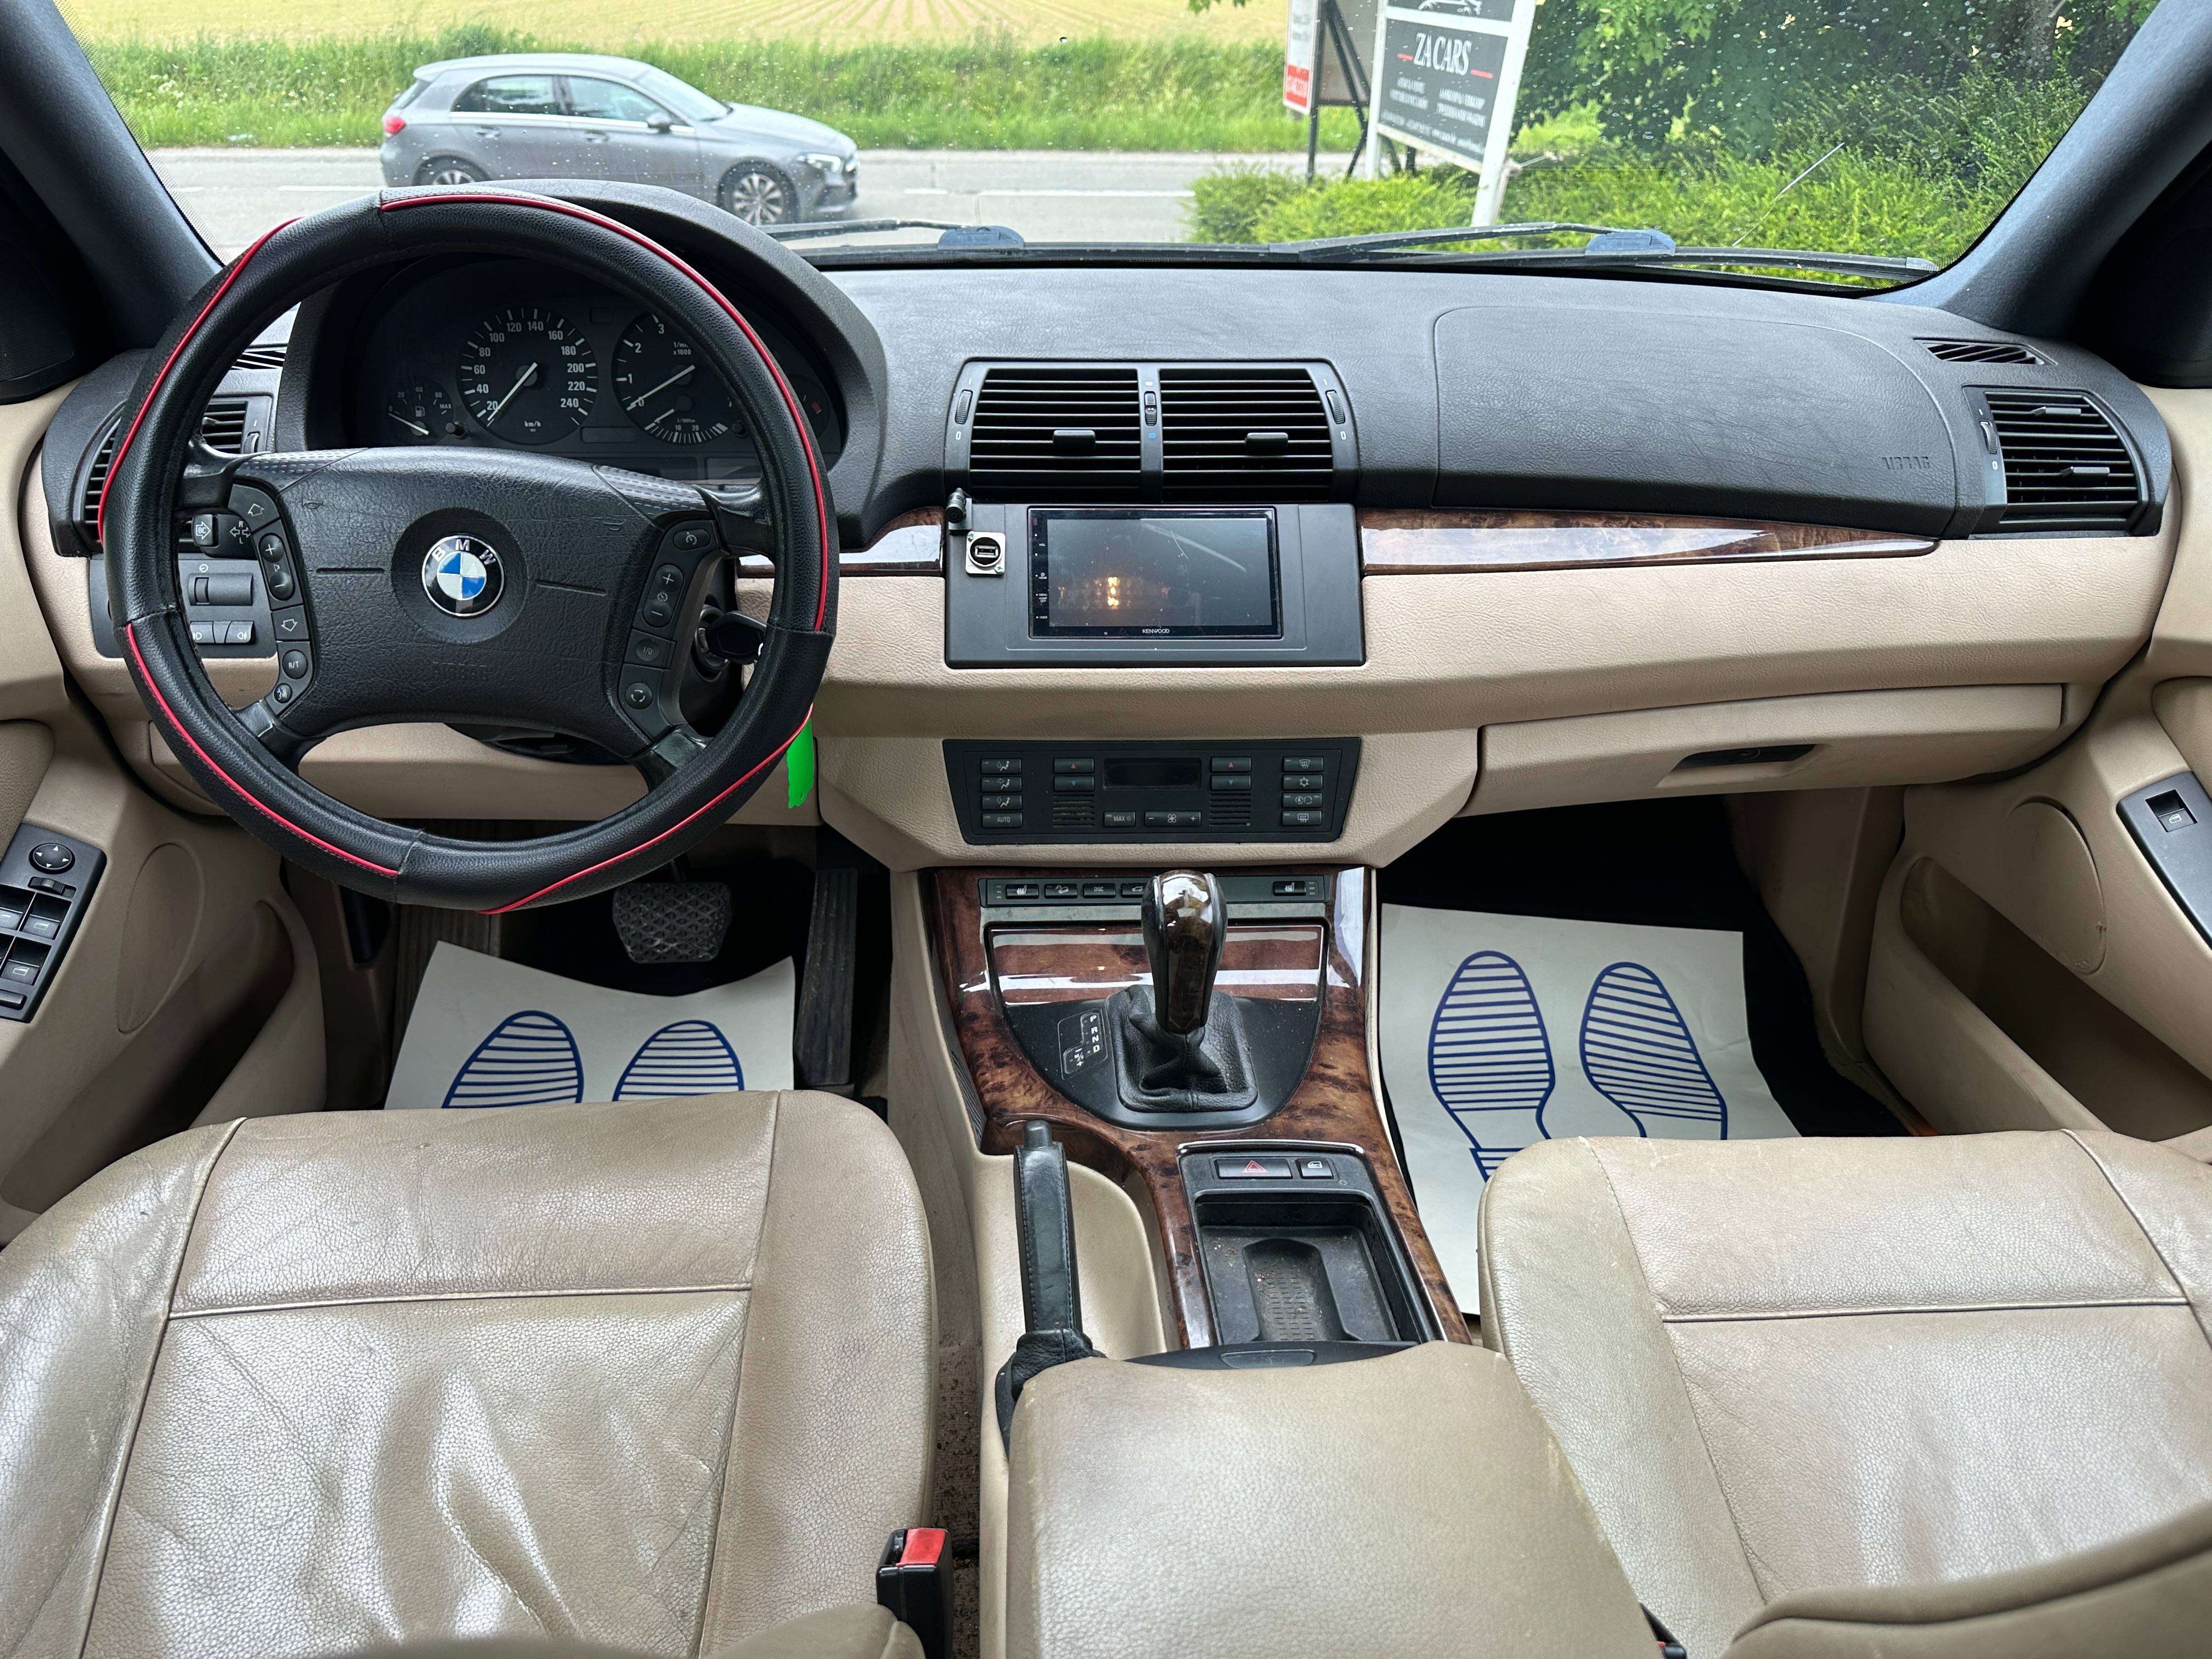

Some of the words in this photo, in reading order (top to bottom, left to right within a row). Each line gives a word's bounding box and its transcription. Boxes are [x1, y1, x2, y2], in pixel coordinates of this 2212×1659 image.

[1414, 33, 1432, 68] ZA
[1433, 36, 1472, 76] CARS
[507, 323, 521, 332] 120
[528, 321, 544, 331] 140
[658, 324, 665, 334] 3
[489, 332, 505, 342] 100
[548, 331, 563, 340] 160
[479, 347, 491, 357] 80
[561, 346, 576, 356] 180
[635, 343, 642, 353] 2
[473, 365, 486, 374] 60
[567, 363, 585, 373] 200
[628, 373, 633, 383] 1
[476, 384, 489, 393] 40
[568, 381, 585, 391] 220
[487, 400, 498, 410] 20
[561, 398, 579, 408] 240
[432, 539, 496, 565] BMW
[1091, 1026, 1098, 1034] R
[1092, 1035, 1099, 1043] N
[1093, 1045, 1100, 1053] D
